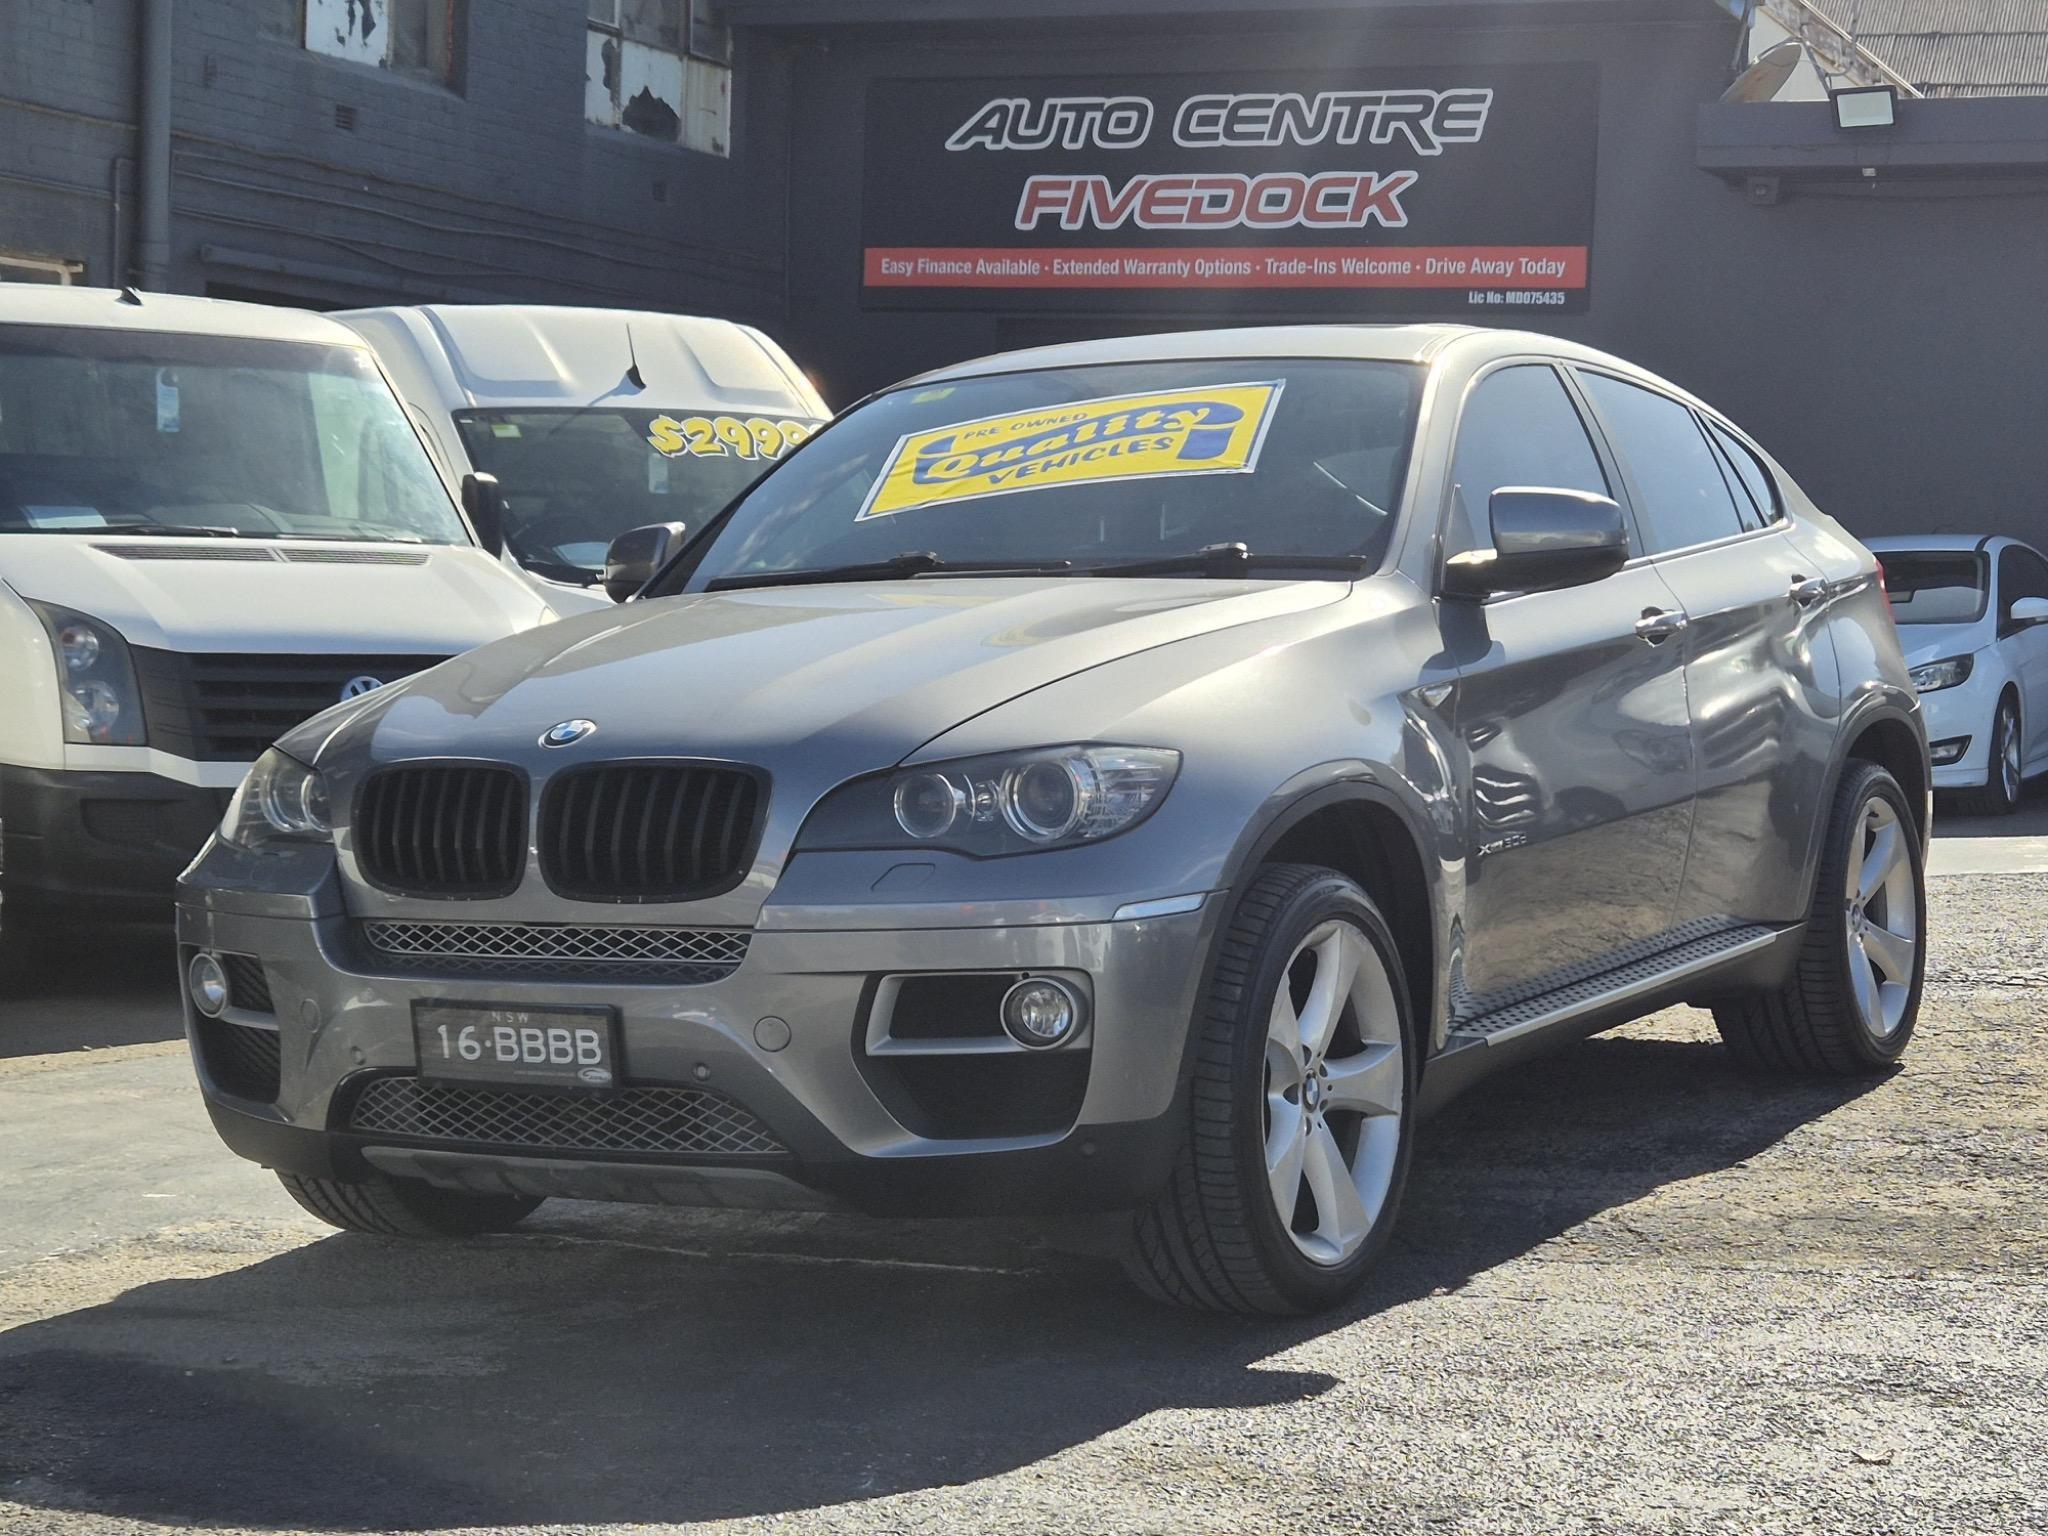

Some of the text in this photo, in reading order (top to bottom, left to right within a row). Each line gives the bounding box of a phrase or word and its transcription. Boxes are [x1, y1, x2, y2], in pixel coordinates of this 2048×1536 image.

[945, 88, 1494, 156] AUTO CENTRE
[1014, 170, 1419, 231] FIVEDOCK
[881, 257, 1566, 278] Easy Finance Available Extended Warranty Options Trade-Ins Welcome Drive Away Today
[1468, 291, 1485, 304] Lic
[1486, 291, 1504, 304] No:
[927, 407, 1210, 479] Quality
[963, 412, 1088, 440] PRE OWNED
[987, 436, 1173, 484] VEHICLES
[491, 1011, 529, 1024] NSW
